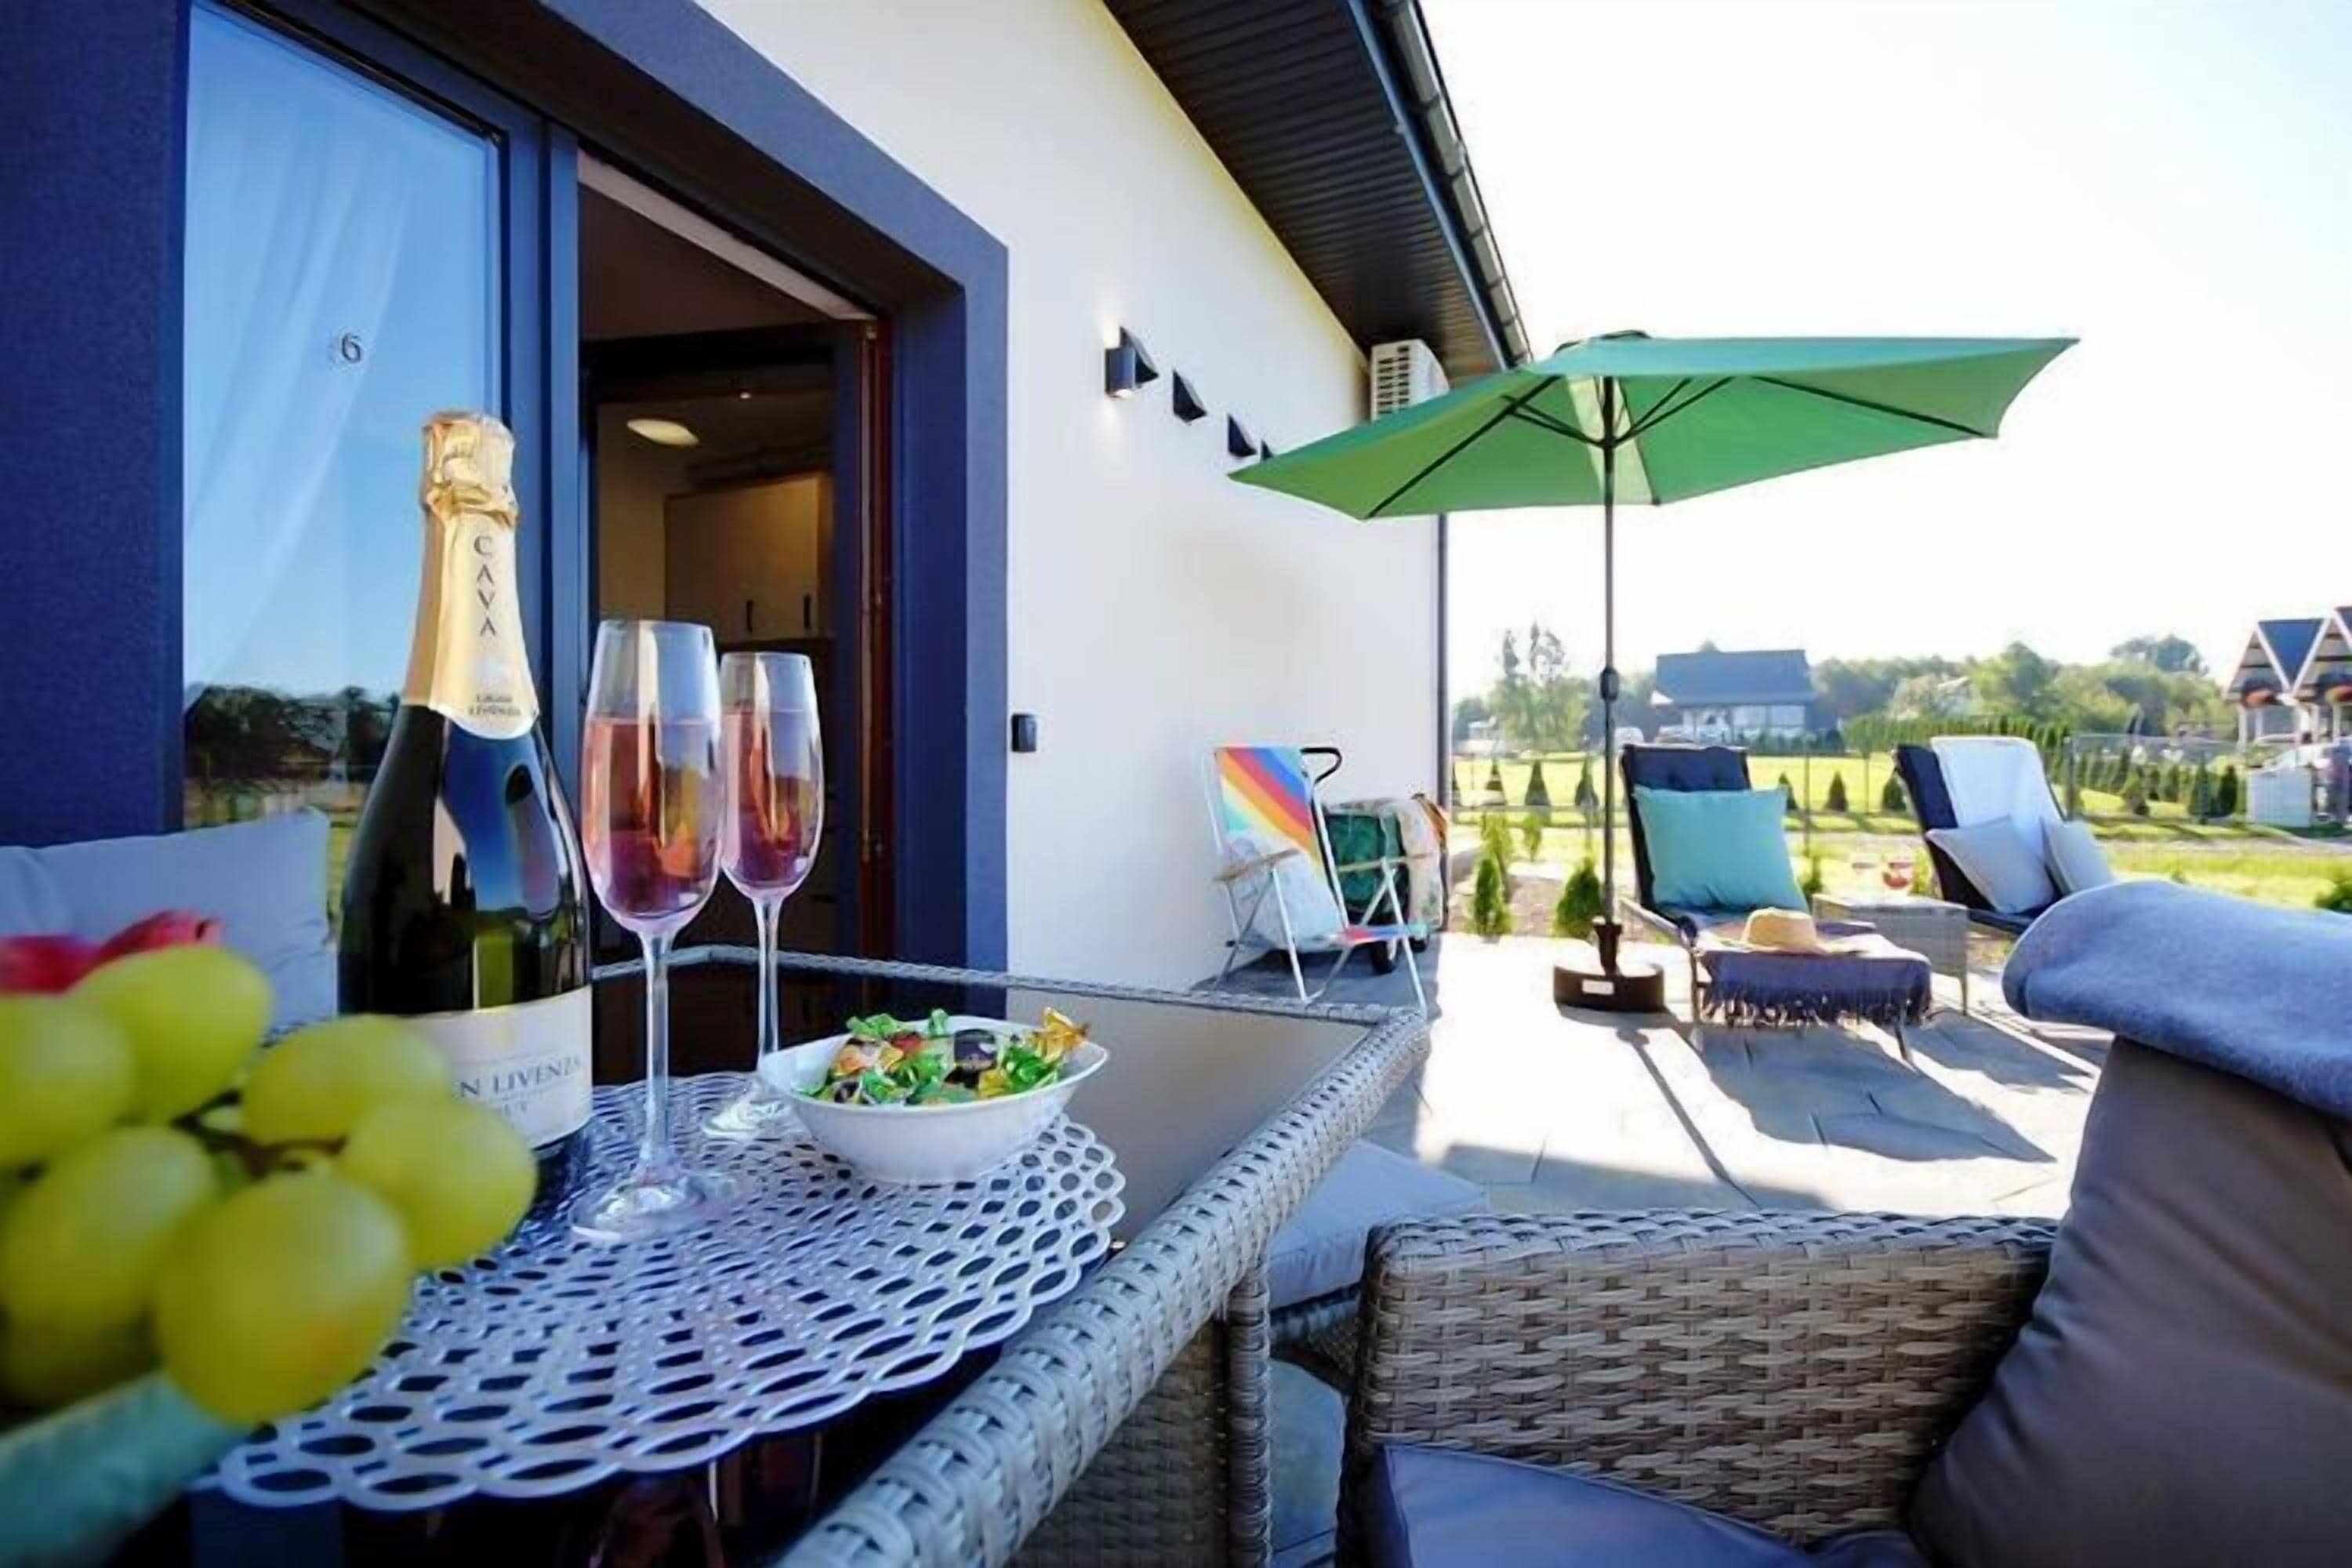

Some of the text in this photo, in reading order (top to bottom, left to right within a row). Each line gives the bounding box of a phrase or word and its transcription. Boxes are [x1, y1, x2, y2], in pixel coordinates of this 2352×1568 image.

[341, 332, 361, 363] 6
[474, 535, 497, 637] CAVA
[456, 1078, 481, 1098] N
